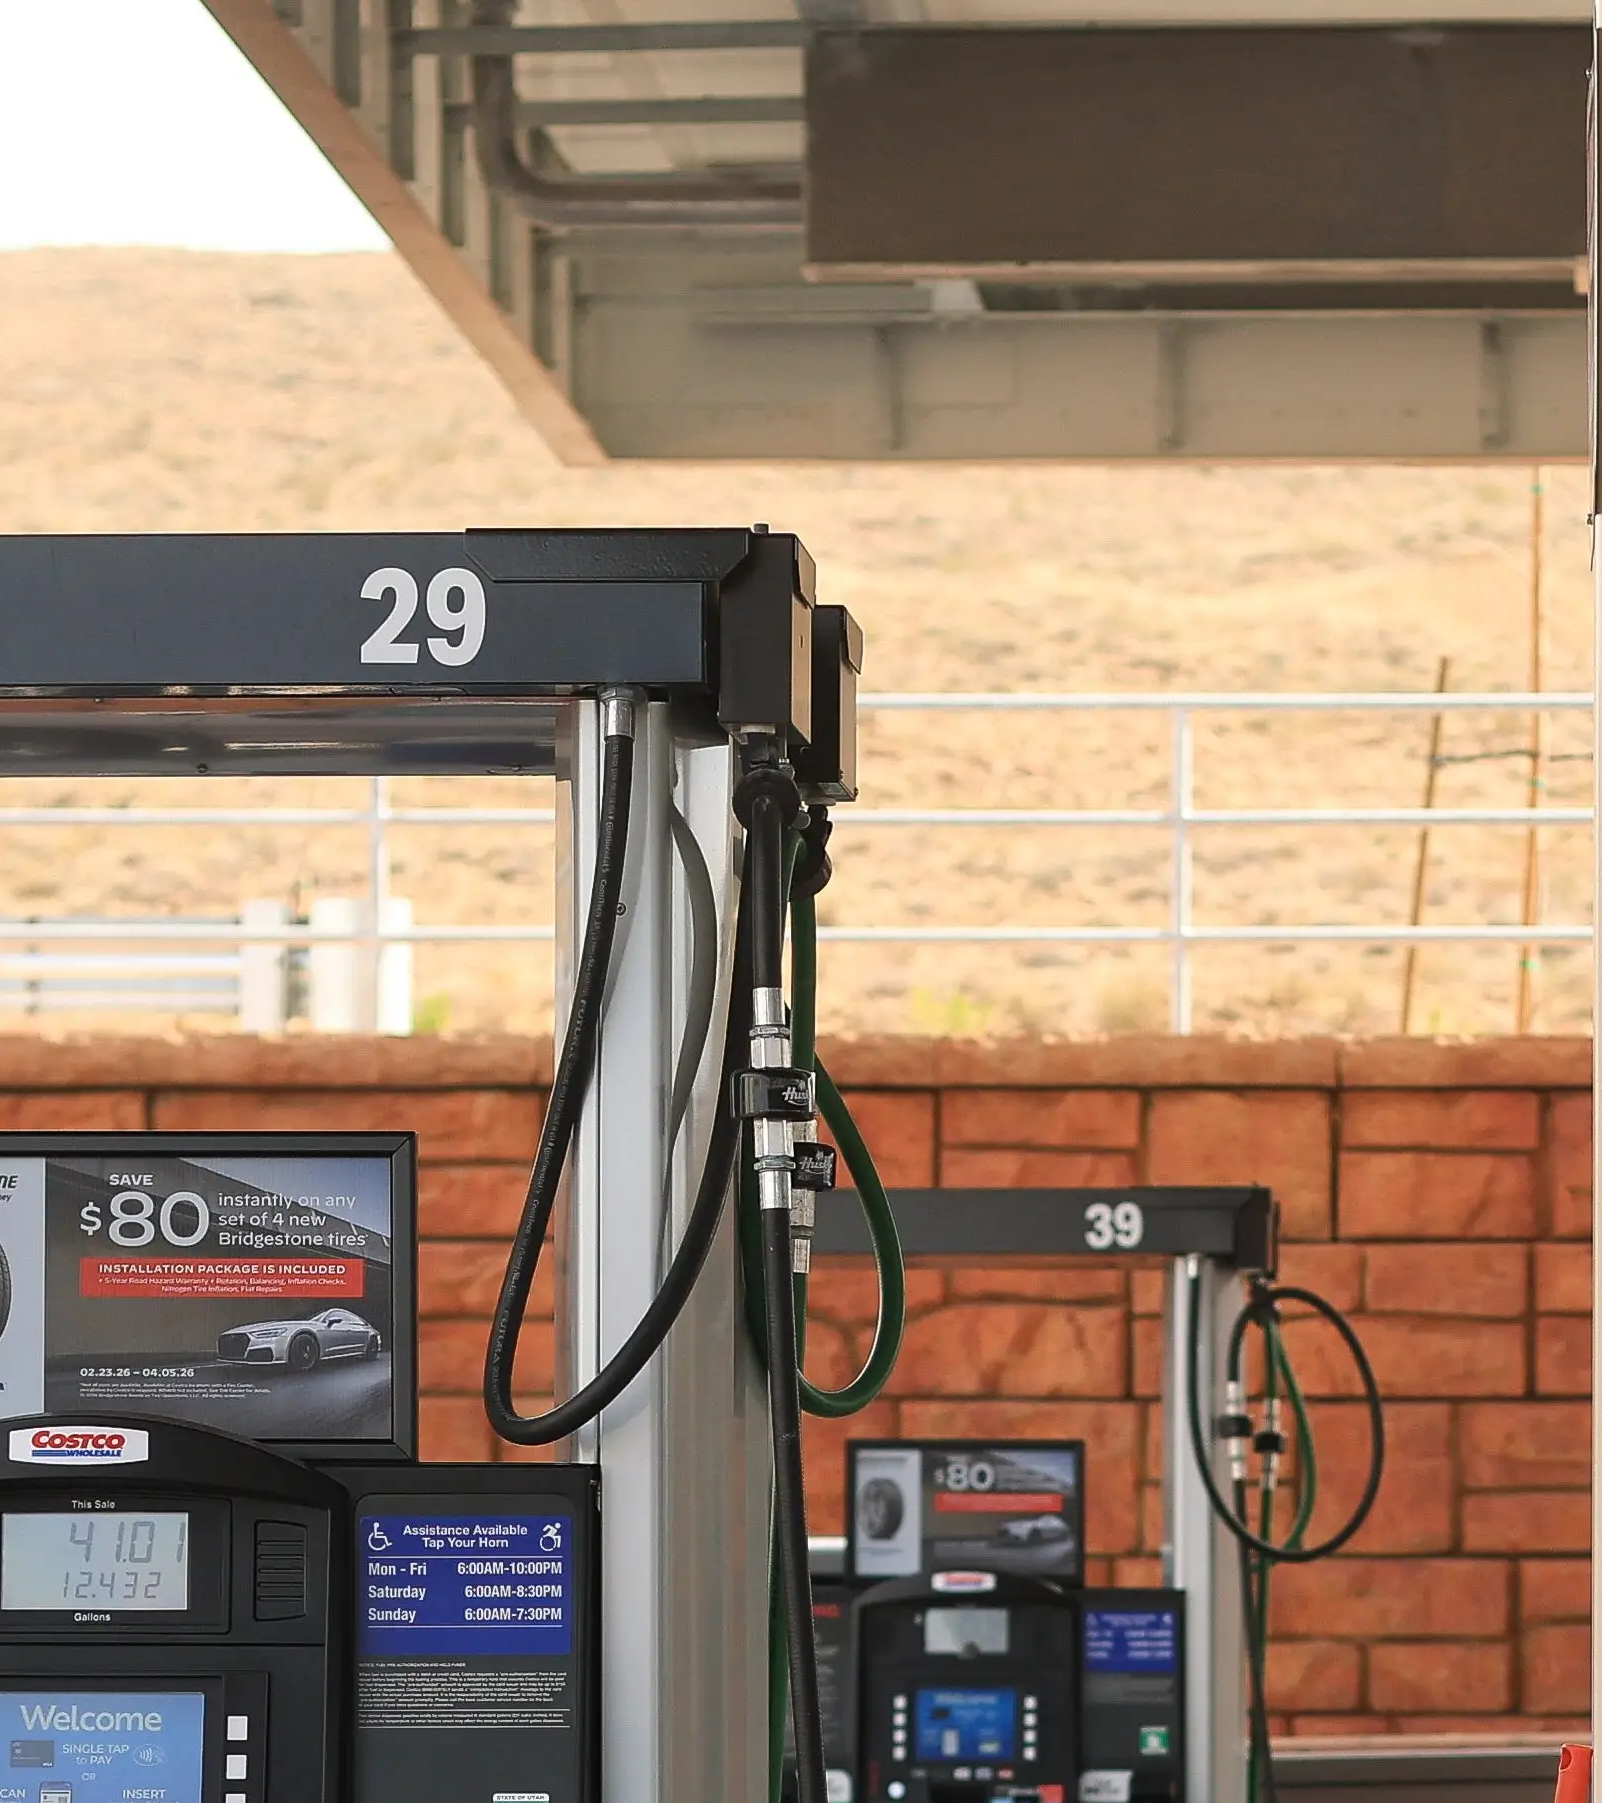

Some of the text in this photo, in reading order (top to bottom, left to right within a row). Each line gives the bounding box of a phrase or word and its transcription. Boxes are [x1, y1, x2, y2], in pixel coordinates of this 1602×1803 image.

[360, 567, 486, 667] 29
[109, 1174, 154, 1186] SAVE
[218, 1192, 356, 1209] instantly on any
[80, 1191, 210, 1247] $80
[218, 1212, 326, 1226] set of 4 new
[1084, 1203, 1142, 1249] 39
[218, 1232, 323, 1248] Bridgestone
[99, 1264, 346, 1276] INSTALLATION PACKAGE IS INCLUDED
[80, 1368, 130, 1377] 02.23.26
[142, 1368, 195, 1377] 04.05.26
[32, 1431, 125, 1449] COSTCO
[66, 1450, 121, 1458] WHOLESALE
[71, 1500, 116, 1509] This Sale
[403, 1525, 527, 1536] Assistance Available
[69, 1521, 186, 1563] 41.01
[422, 1538, 508, 1549] Tap Your Horn
[368, 1563, 396, 1576] Mon
[410, 1562, 427, 1575] Fri
[457, 1562, 562, 1575] 6:00AM-10:00PM
[63, 1572, 161, 1598] 12.432
[465, 1585, 562, 1598] 6:00AM-8:30PM
[368, 1585, 426, 1600] Saturday
[73, 1613, 111, 1622] Gallons
[368, 1608, 416, 1623] Sunday
[464, 1608, 562, 1620] 6:00AM-7:30PM
[20, 1705, 162, 1731] Welcome
[62, 1744, 130, 1754] SINGLE TAP
[76, 1756, 112, 1765] to PAY
[122, 1789, 166, 1799] INSERT
